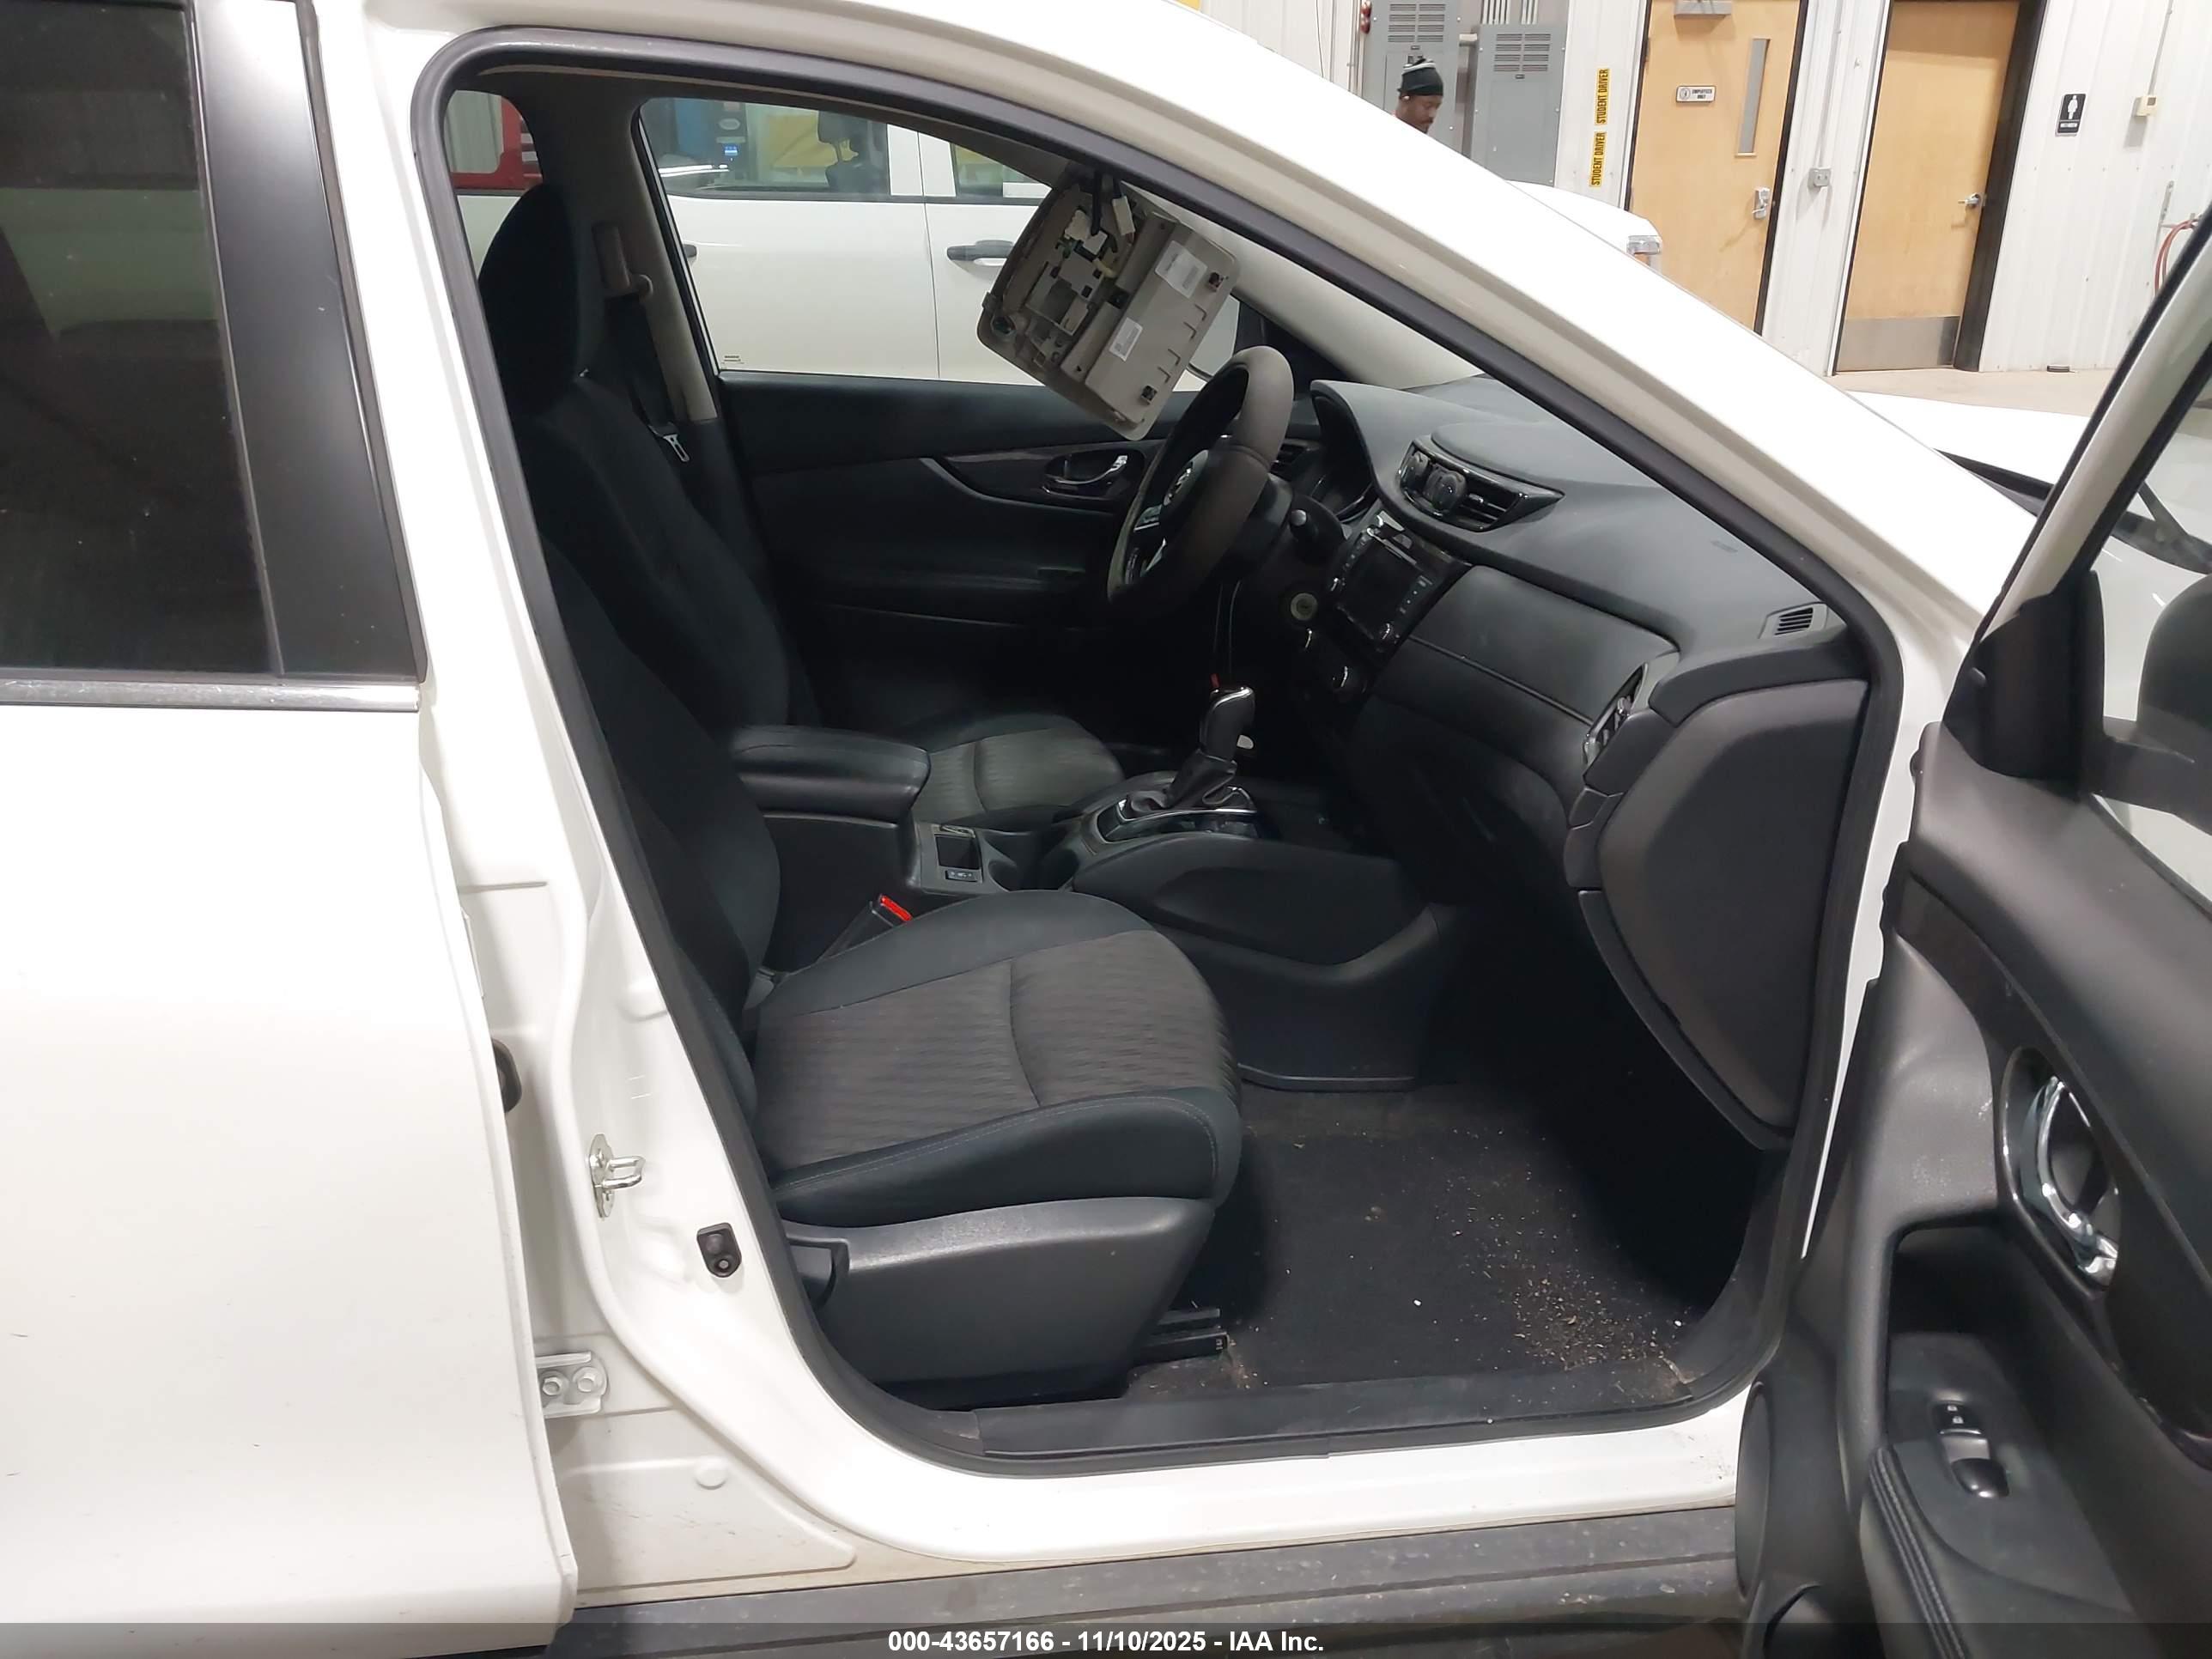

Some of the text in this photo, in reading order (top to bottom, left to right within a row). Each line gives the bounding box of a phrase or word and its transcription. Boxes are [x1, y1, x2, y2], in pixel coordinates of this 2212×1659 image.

[1596, 69, 1609, 124] STUDENT DRIVER
[1591, 132, 1606, 185] STUDENT DRIVER
